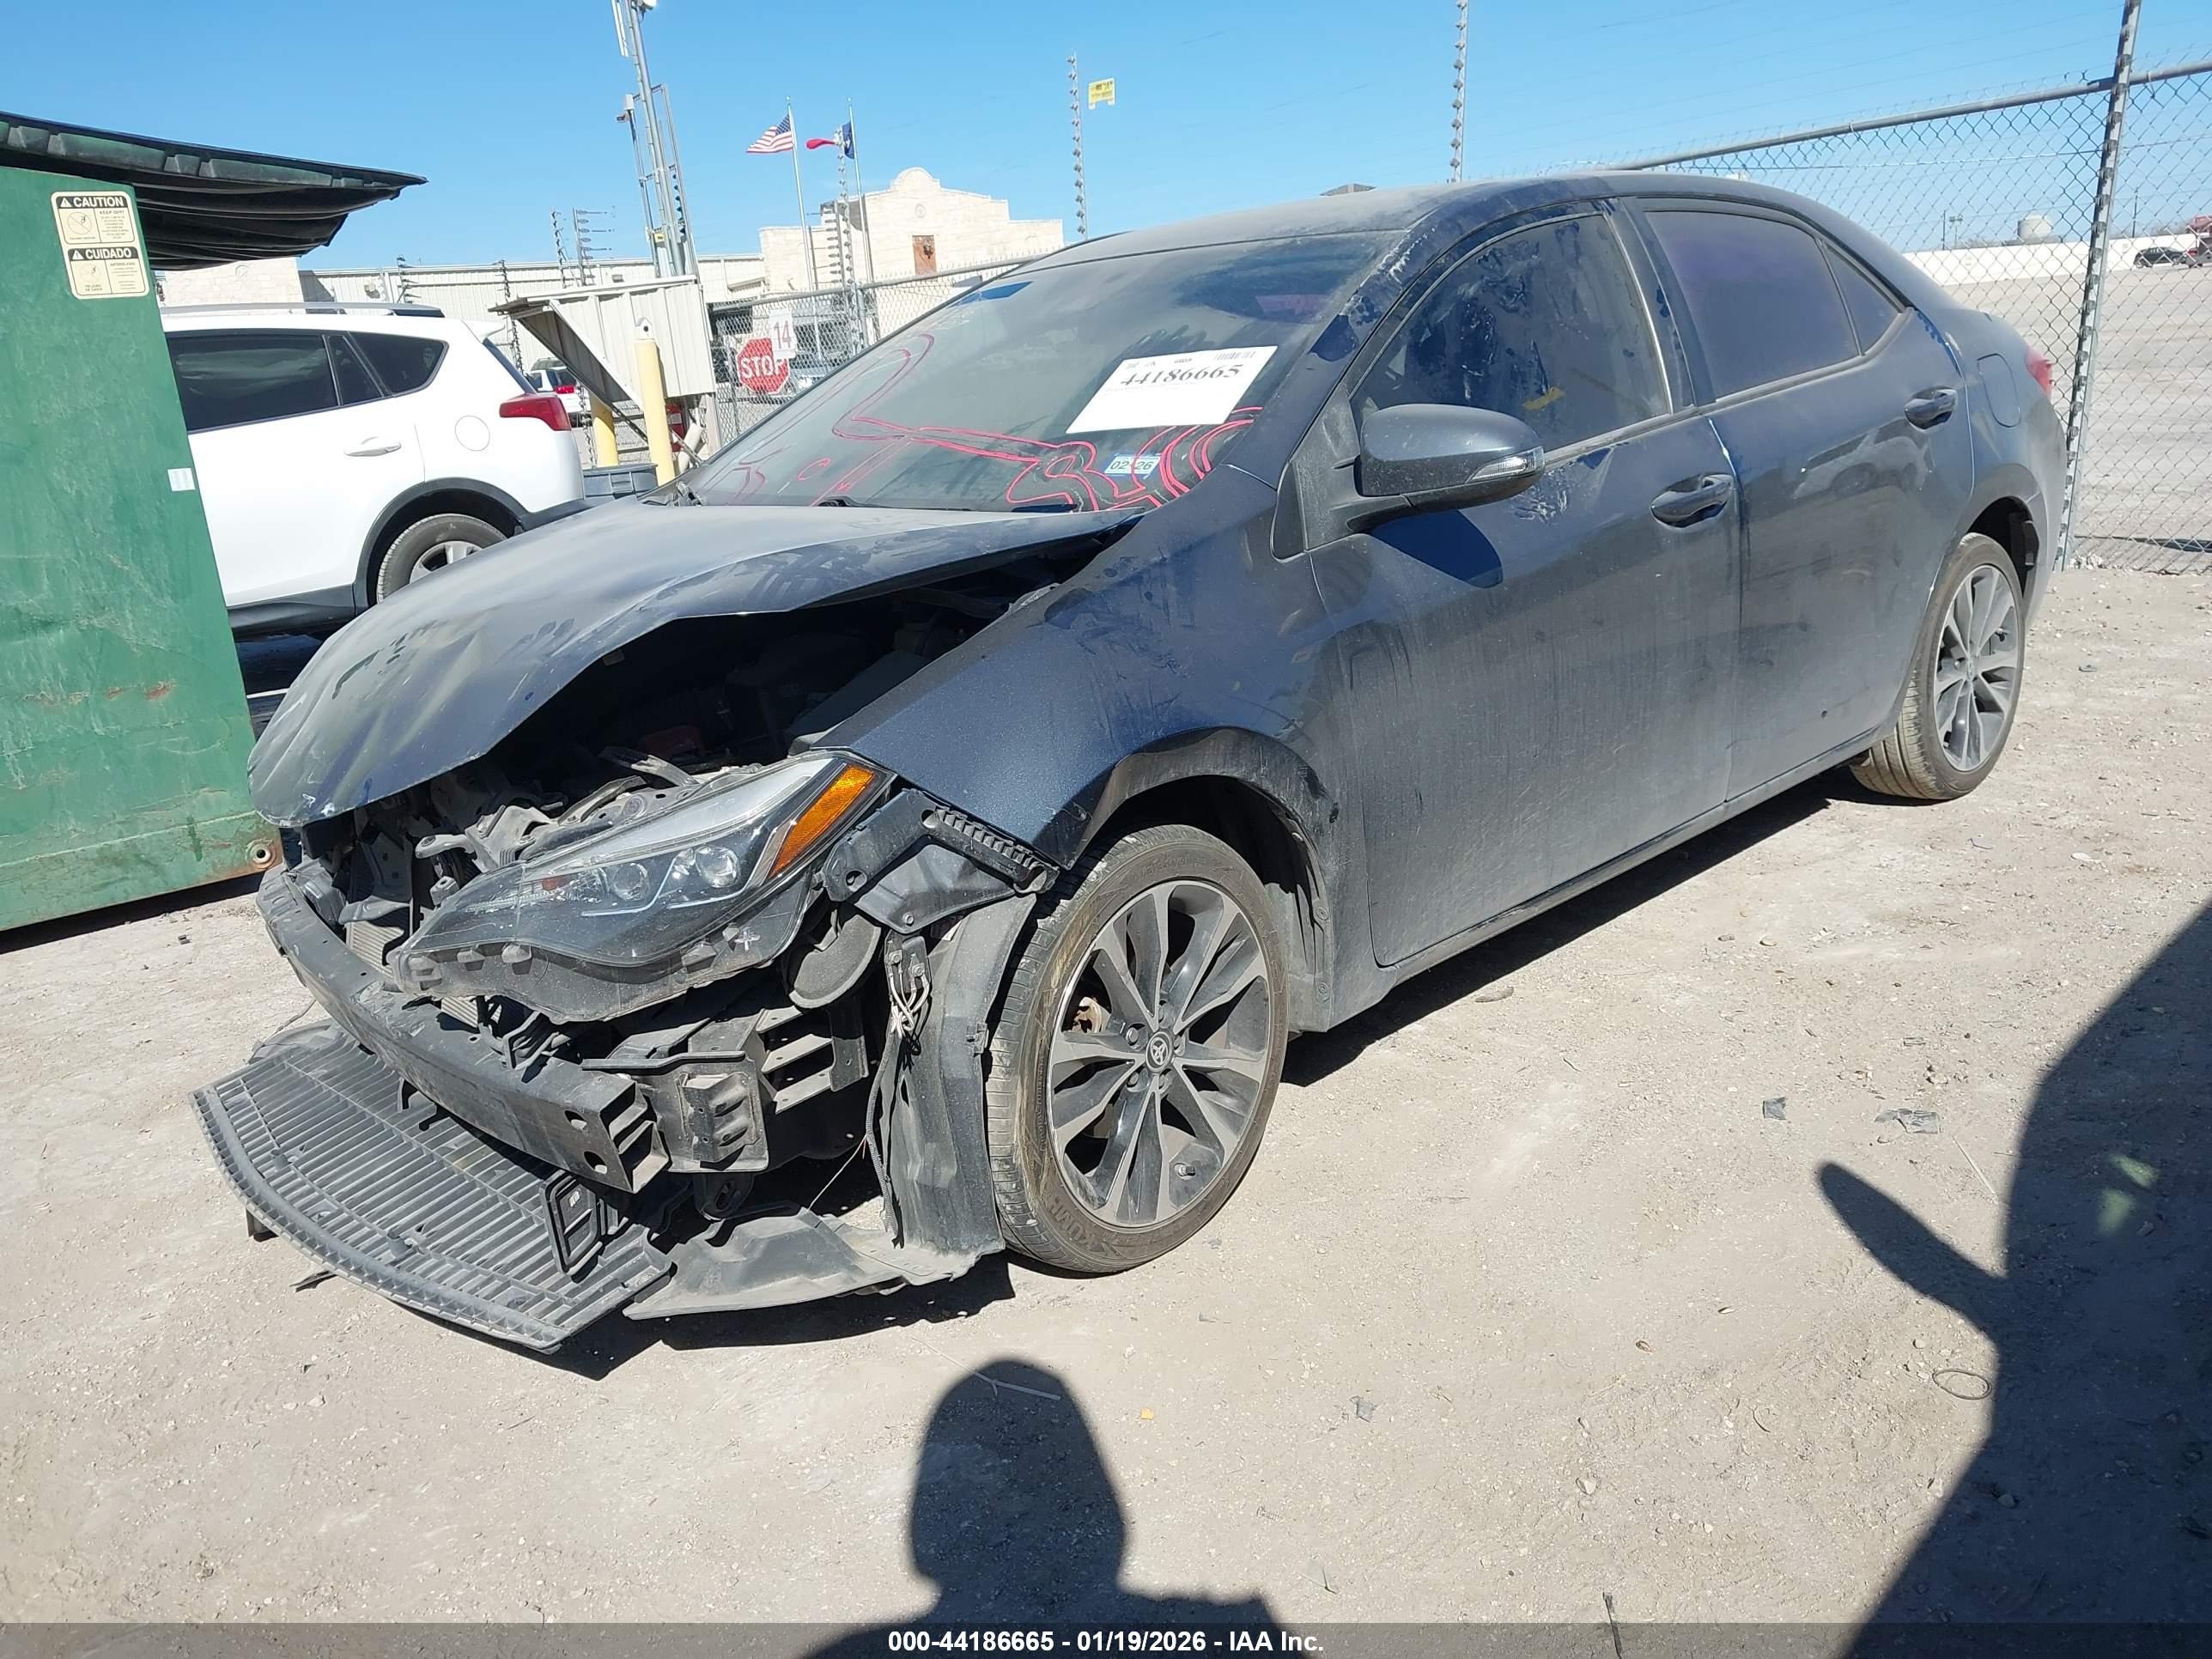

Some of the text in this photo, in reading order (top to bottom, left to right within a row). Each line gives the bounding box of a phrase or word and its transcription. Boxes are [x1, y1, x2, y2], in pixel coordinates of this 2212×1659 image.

[73, 197, 124, 208] CAUTION
[85, 248, 131, 259] CUIDADO
[773, 320, 792, 349] 14
[740, 355, 784, 379] STOP
[1120, 364, 1244, 386] 44186665
